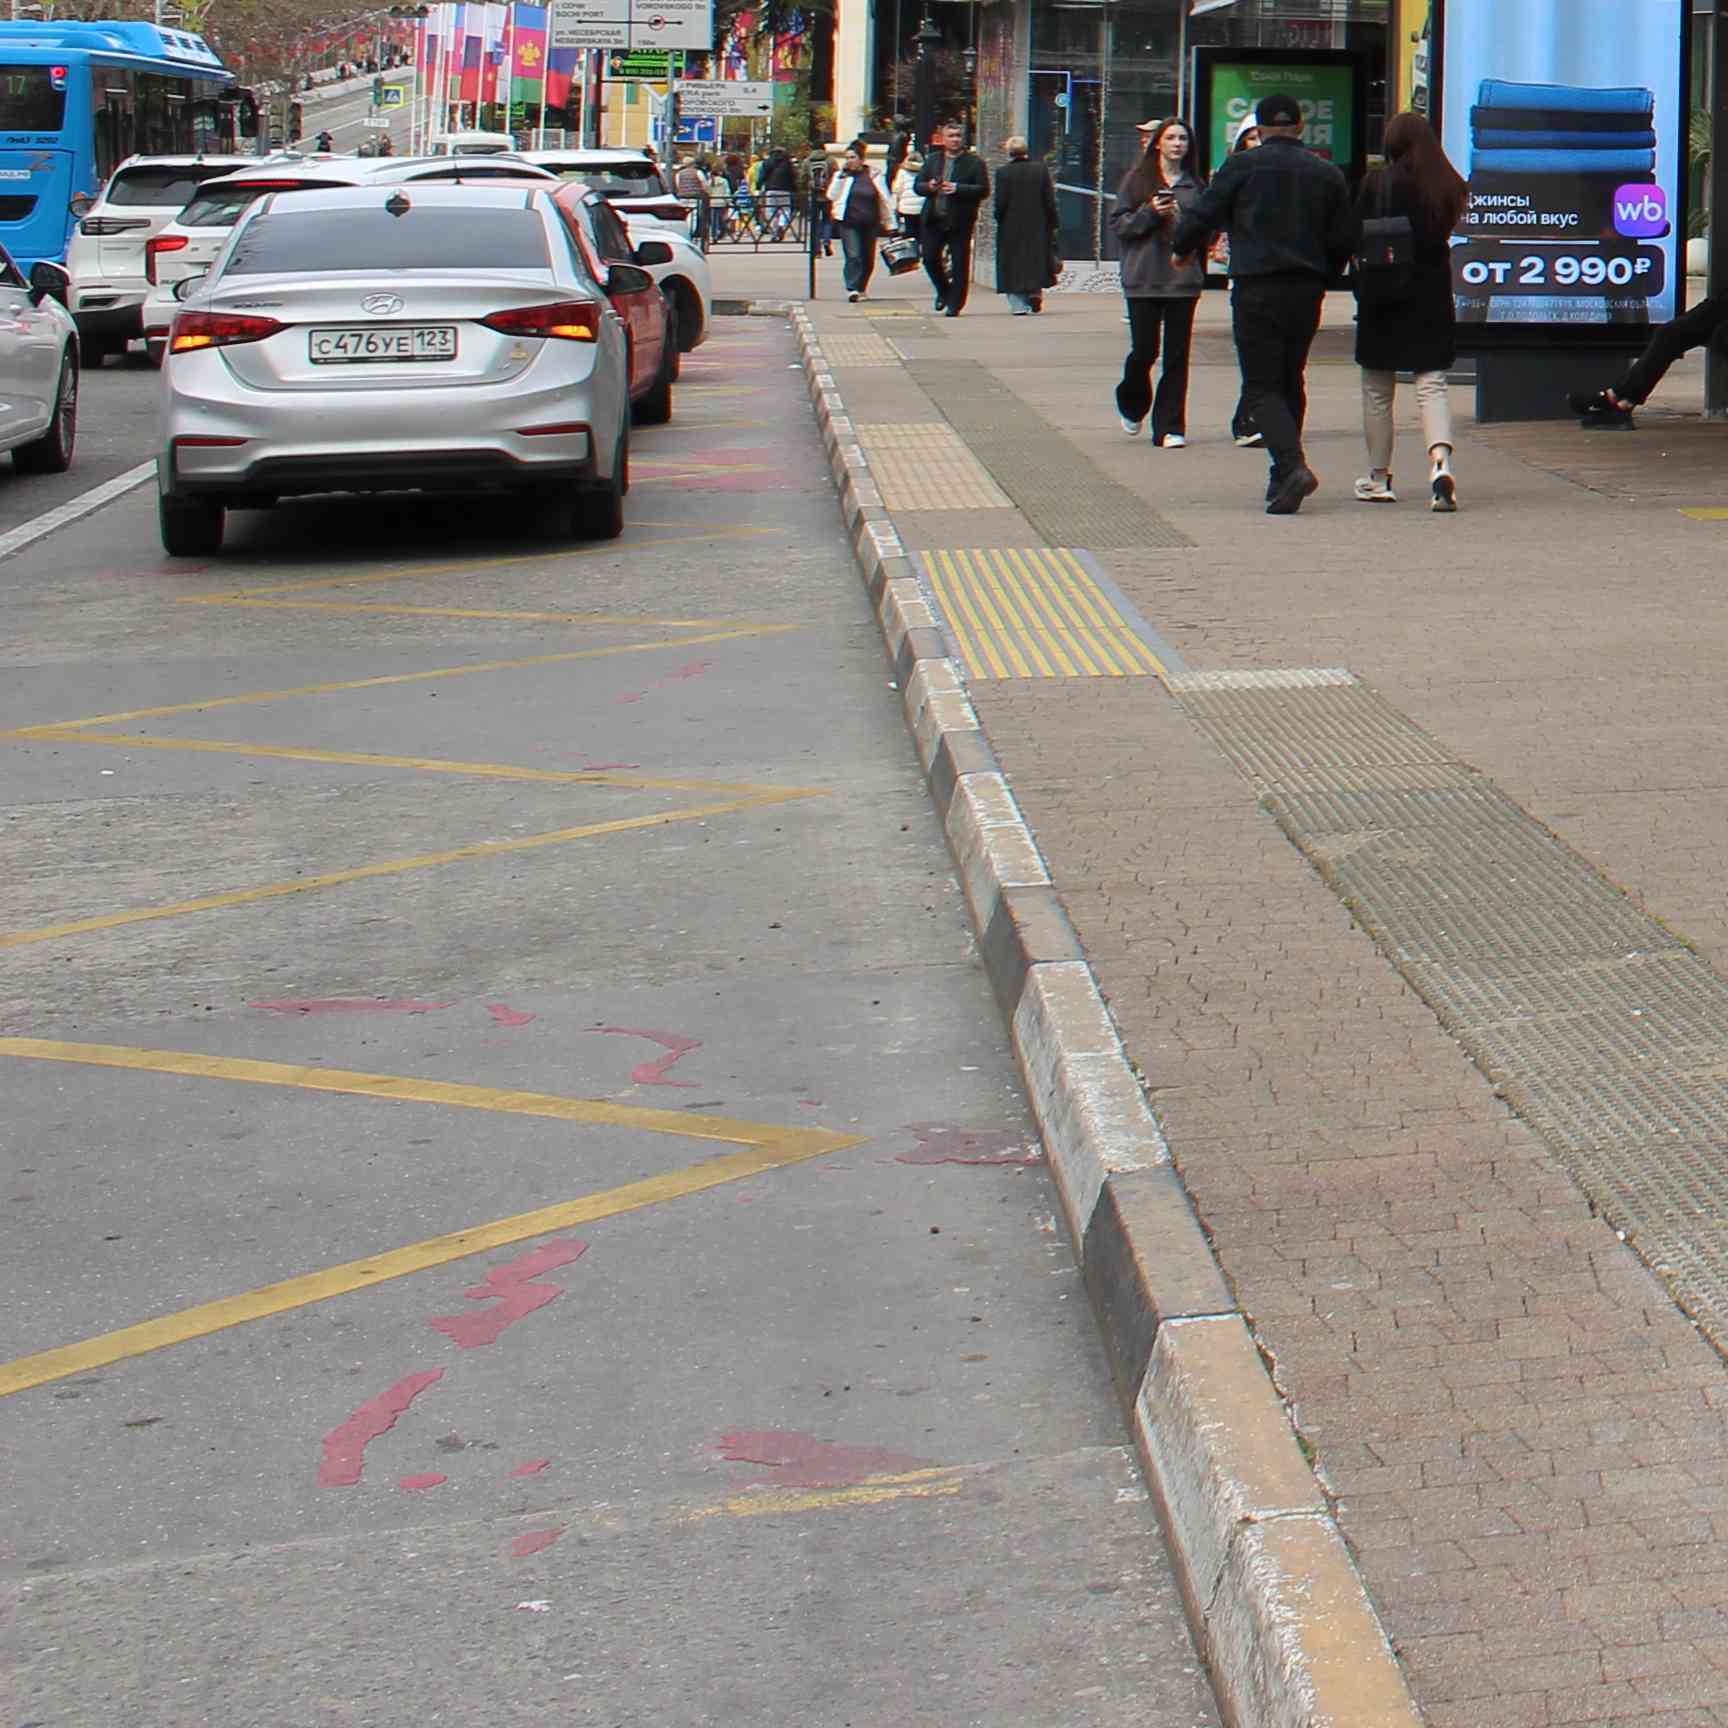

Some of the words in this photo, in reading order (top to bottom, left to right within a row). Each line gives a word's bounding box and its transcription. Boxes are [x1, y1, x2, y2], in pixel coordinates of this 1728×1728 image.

[1481, 209, 1537, 226] любой
[1541, 212, 1578, 228] вкус
[1617, 194, 1663, 221] wb
[1462, 260, 1512, 285] от
[1519, 256, 1546, 284] 2
[415, 329, 450, 350] 123
